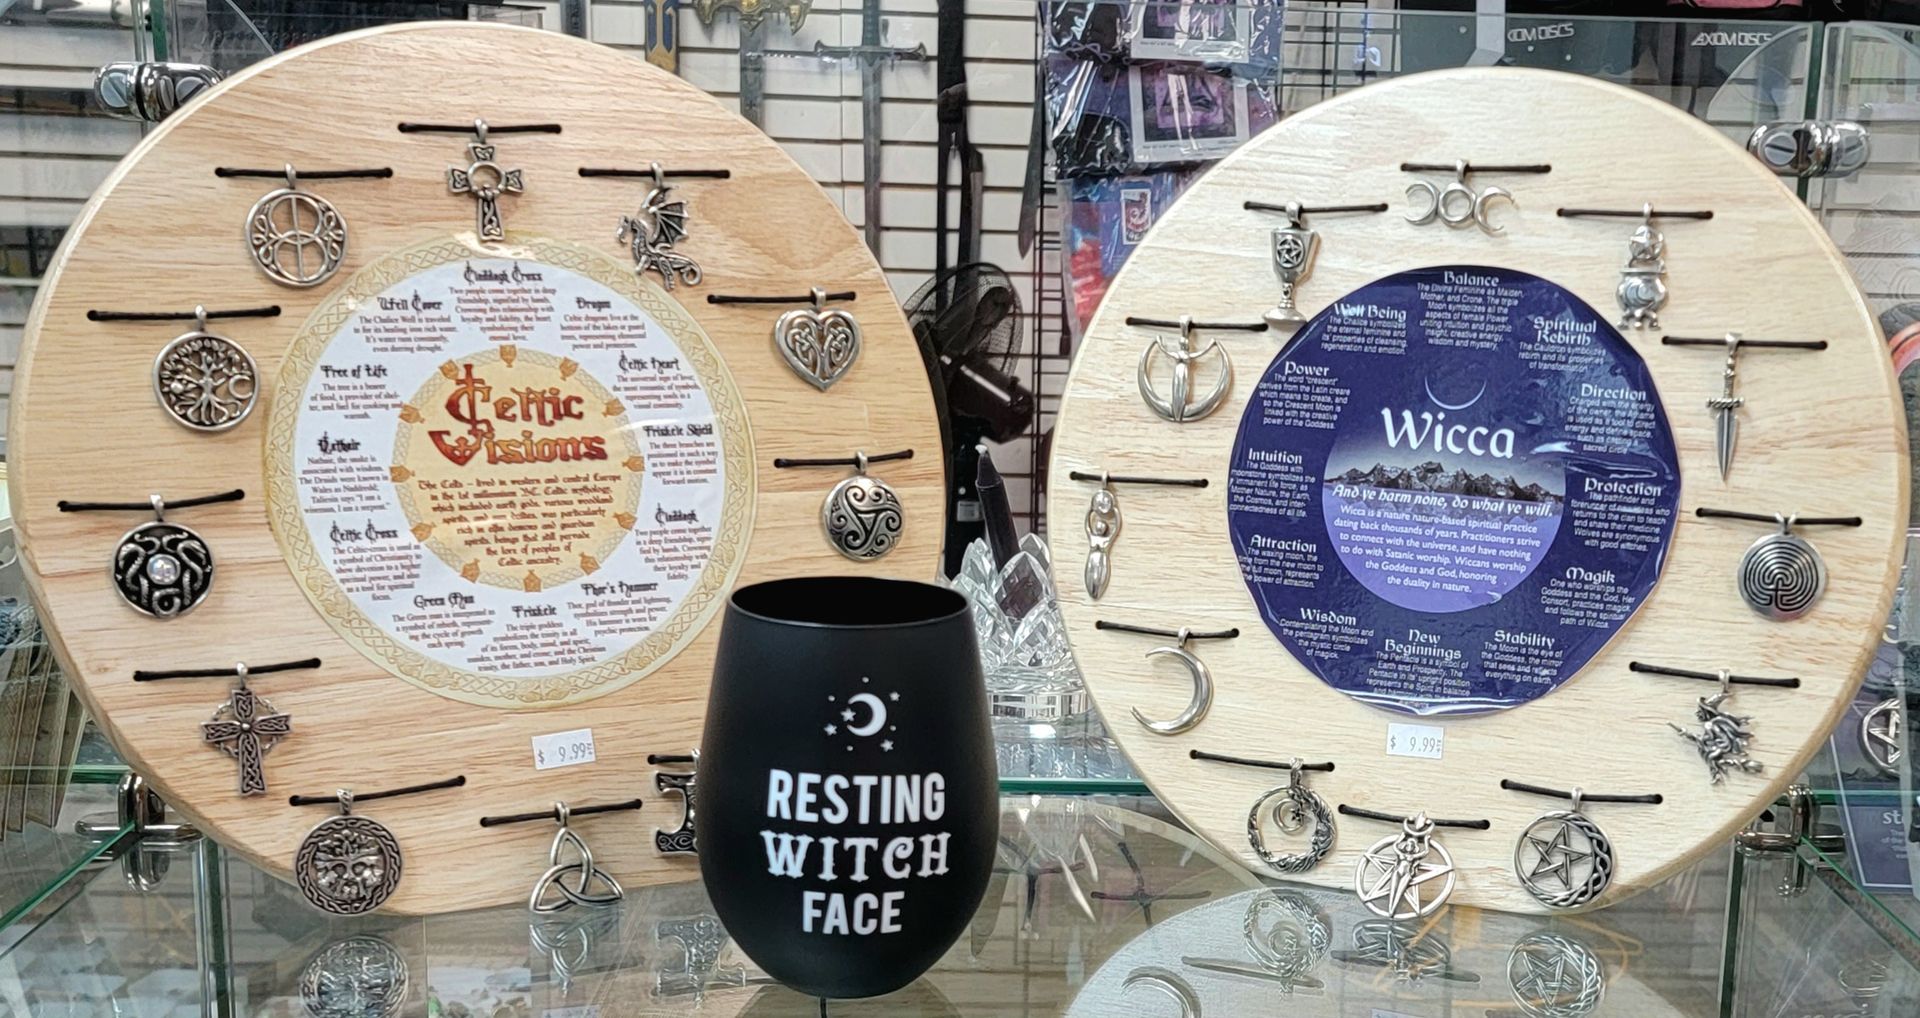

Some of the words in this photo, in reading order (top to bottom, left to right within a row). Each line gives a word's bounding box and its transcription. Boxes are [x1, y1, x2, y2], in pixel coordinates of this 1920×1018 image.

[1538, 23, 1574, 39] DISCS
[1691, 32, 1736, 45] AXIOM
[1444, 271, 1499, 287] Balance
[576, 297, 611, 312] Dragon
[1368, 305, 1406, 321] Being
[1533, 317, 1596, 334] Spiritual
[1538, 331, 1590, 345] Rebirth
[321, 365, 349, 378] Tree
[352, 365, 361, 378] of
[365, 364, 388, 378] Life
[619, 350, 647, 374] Celtic
[651, 357, 680, 374] Heart
[1285, 361, 1329, 376] Power
[445, 364, 583, 430] Celtic
[1581, 383, 1646, 400] Direction
[1381, 407, 1515, 459] Wicca
[428, 430, 608, 466] Visions
[1248, 448, 1302, 464] Intuition
[1585, 478, 1662, 496] Protection
[1332, 485, 1359, 498] And
[1362, 489, 1376, 501] ye
[1379, 489, 1411, 503] harm
[1414, 495, 1447, 509] none,
[1452, 495, 1468, 508] do
[1472, 498, 1504, 511] what
[1508, 503, 1521, 515] ye
[1526, 504, 1552, 517] will.
[1341, 505, 1365, 516] Wicca
[1368, 509, 1374, 517] is
[1384, 511, 1410, 520] nature
[1413, 514, 1465, 526] nature-based
[1468, 520, 1501, 529] spiritual
[1504, 524, 1537, 533] practice
[330, 521, 361, 544] Celtic
[365, 519, 399, 543] Cross
[1334, 518, 1358, 530] dating
[1361, 521, 1379, 530] back
[1382, 524, 1422, 535] thousands
[1425, 528, 1434, 536] of
[1435, 530, 1459, 539] years.
[1461, 531, 1514, 544] Practitioners
[1517, 538, 1540, 547] strive
[1251, 534, 1317, 553] Attraction
[1351, 534, 1383, 544] connect
[1386, 538, 1403, 546] with
[1407, 539, 1419, 547] the
[1422, 541, 1459, 552] universe,
[1461, 545, 1475, 553] and
[1478, 546, 1496, 555] have
[1499, 550, 1531, 561] nothing
[1352, 546, 1363, 554] do
[1366, 548, 1383, 556] with
[1386, 549, 1414, 559] Satanic
[1416, 554, 1451, 565] worship.
[1455, 556, 1489, 568] Wiccans
[1493, 561, 1526, 573] worship
[1366, 561, 1379, 569] the
[1381, 561, 1417, 573] Goddess
[1437, 568, 1458, 578] God,
[1459, 570, 1497, 584] honoring
[1566, 567, 1615, 584] Magik
[1387, 576, 1401, 584] the
[1403, 578, 1430, 590] duality
[1442, 583, 1472, 592] nature.
[1301, 608, 1356, 625] Wisdom
[1409, 629, 1440, 644] New
[1494, 630, 1555, 649] Stability
[1385, 639, 1462, 660] Beginnings
[1391, 735, 1396, 750] $
[1410, 737, 1435, 752] 9.99
[538, 750, 545, 764] $
[559, 743, 585, 762] 9.99
[767, 769, 945, 824] RESTING
[759, 829, 952, 882] WITCH
[802, 890, 905, 935] FACE
